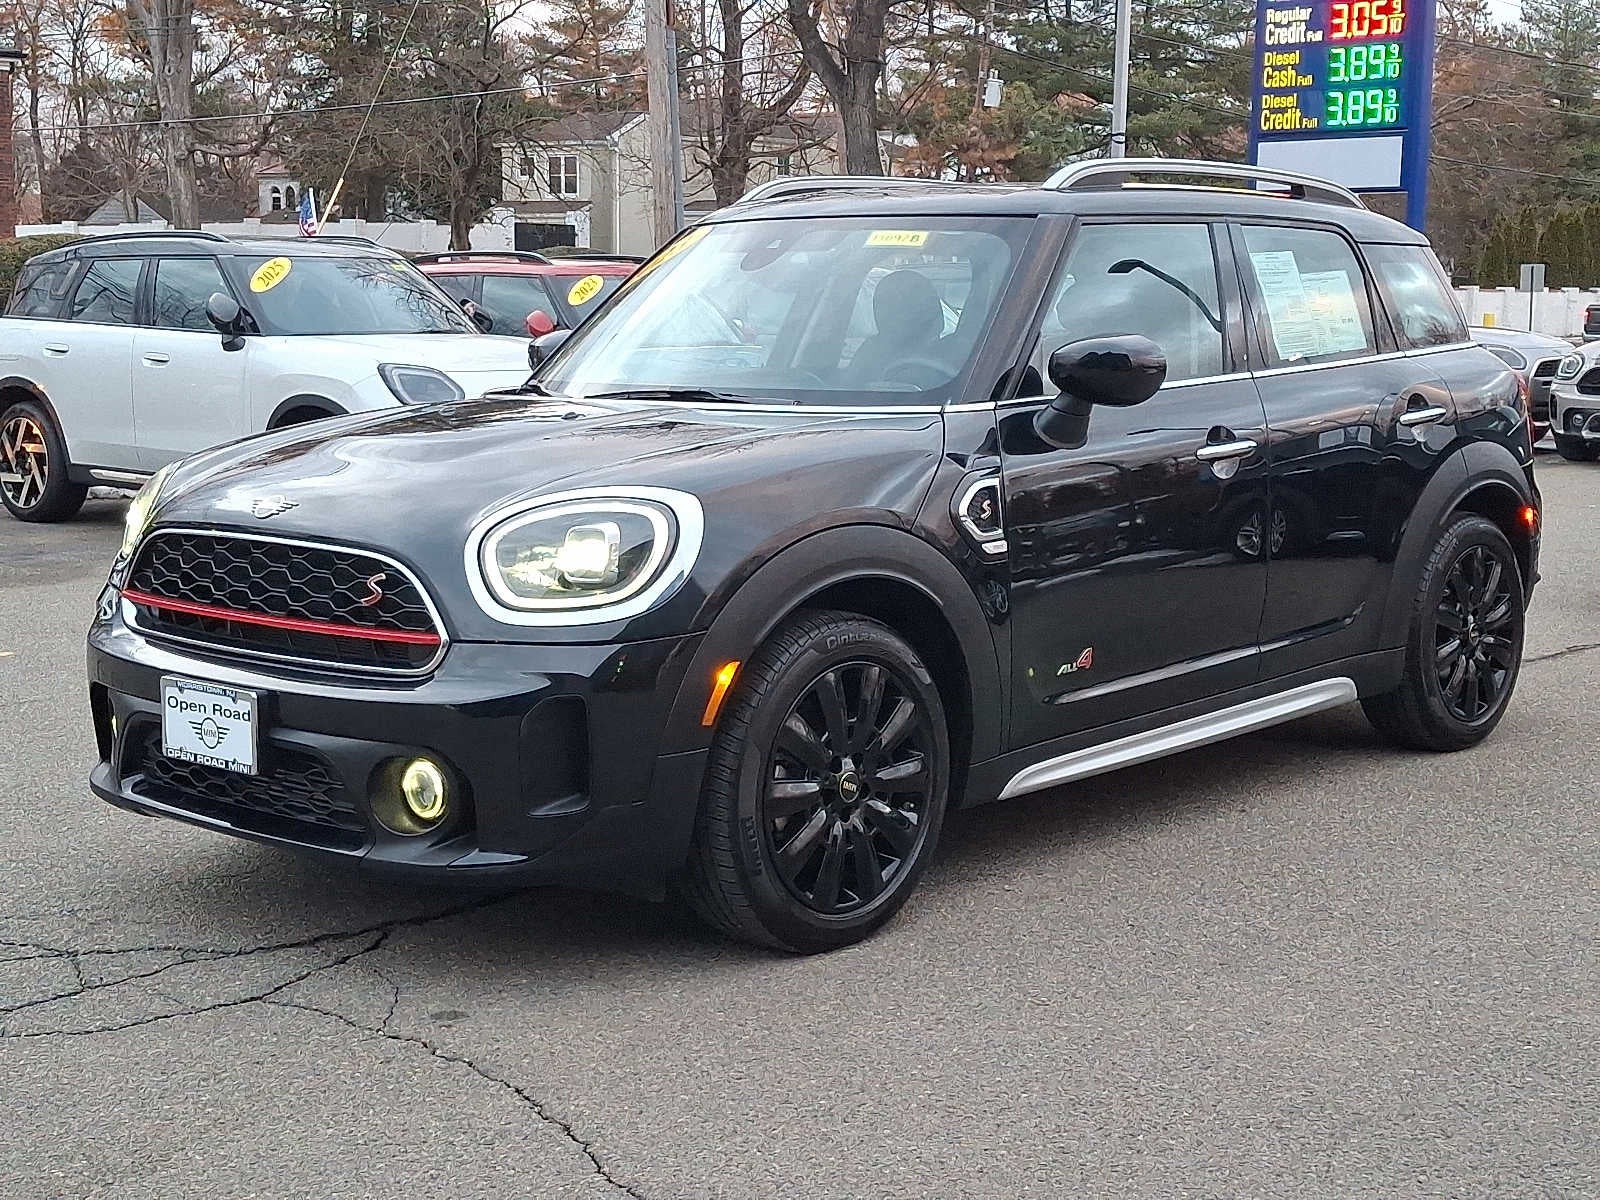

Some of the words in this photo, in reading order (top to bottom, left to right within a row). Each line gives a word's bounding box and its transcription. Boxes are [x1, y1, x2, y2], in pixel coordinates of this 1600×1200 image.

[1266, 6, 1312, 25] Regular
[1330, 0, 1388, 39] 3.05
[1265, 21, 1307, 45] Credit
[1306, 30, 1323, 42] Full
[1263, 50, 1300, 67] Diesel
[1327, 44, 1387, 83] 3.89
[1263, 67, 1297, 88] Cash
[1296, 75, 1313, 87] Full
[1262, 93, 1298, 109] Diesel
[1326, 89, 1384, 127] 3.89
[1260, 110, 1302, 131] Credit
[1301, 117, 1318, 129] Full
[257, 260, 285, 288] 2025
[980, 499, 992, 520] S
[361, 573, 387, 606] S
[167, 695, 207, 714] Open
[212, 703, 251, 723] Road
[167, 748, 195, 763] OPEN
[196, 755, 226, 769] ROAD
[228, 761, 252, 775] MINI
